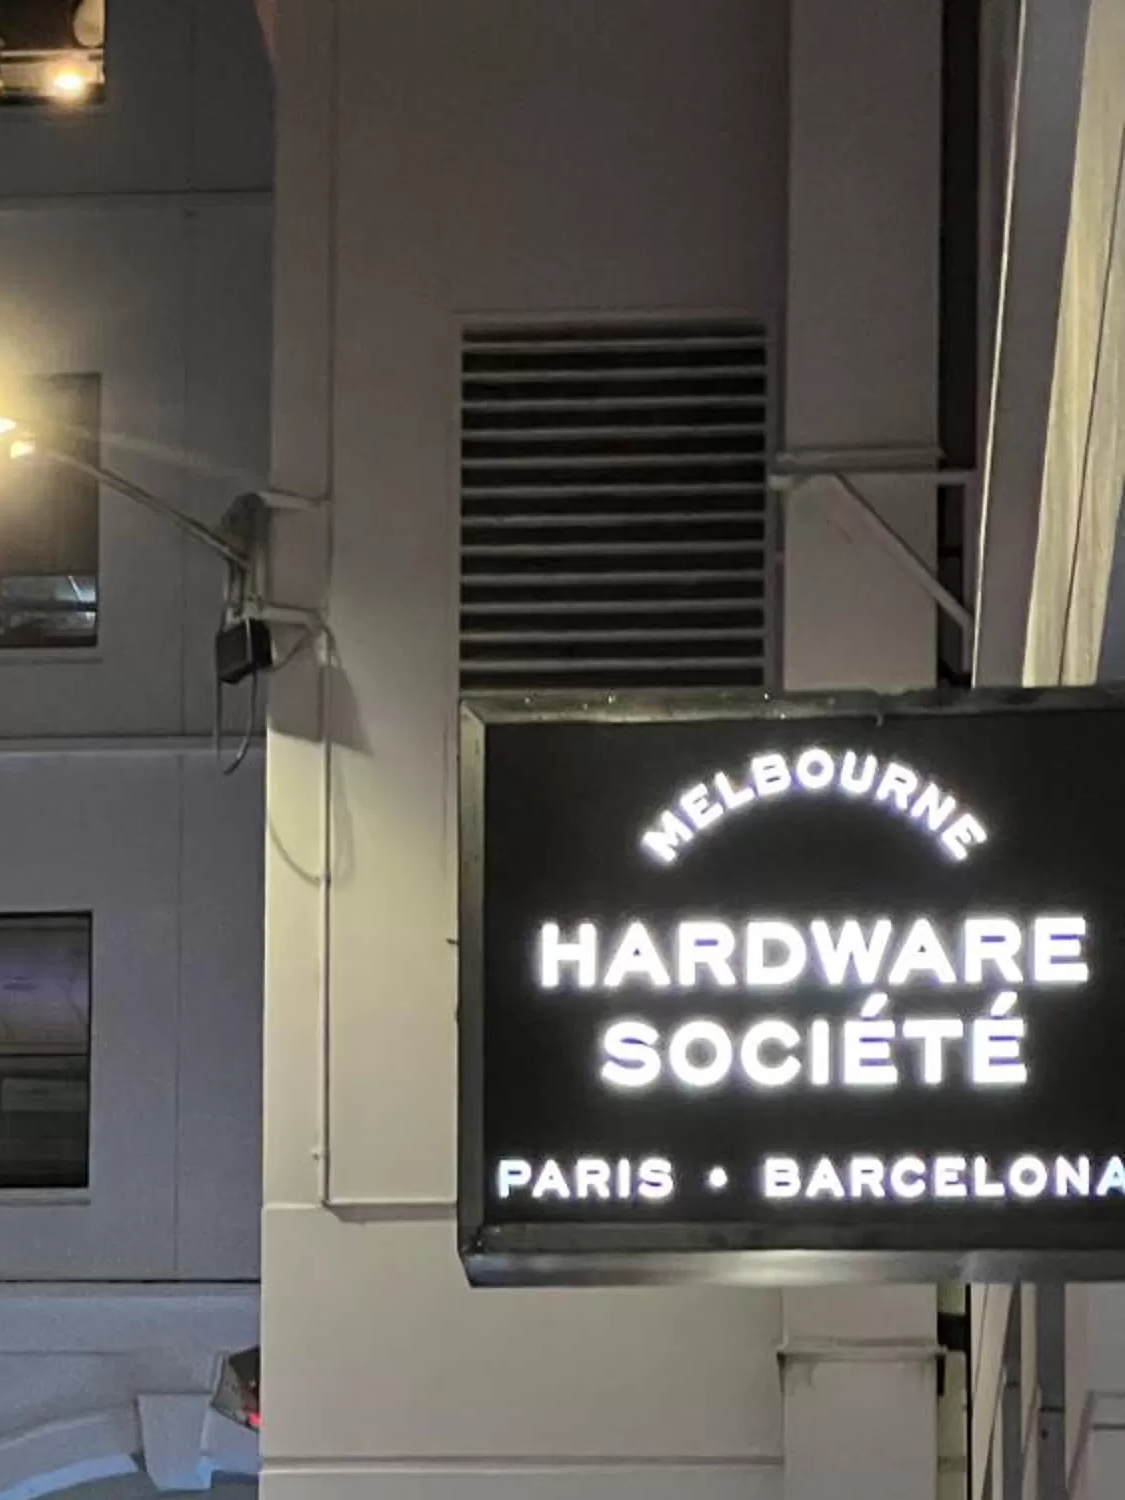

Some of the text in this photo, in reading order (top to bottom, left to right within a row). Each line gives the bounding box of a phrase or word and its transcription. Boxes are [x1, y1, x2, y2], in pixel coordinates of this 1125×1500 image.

[641, 746, 987, 864] MELBOURNE
[538, 915, 1089, 987] HARDWARE
[600, 992, 1028, 1087] SOCIÉTÉ
[498, 1155, 1125, 1200] PARIS BARCELONA
